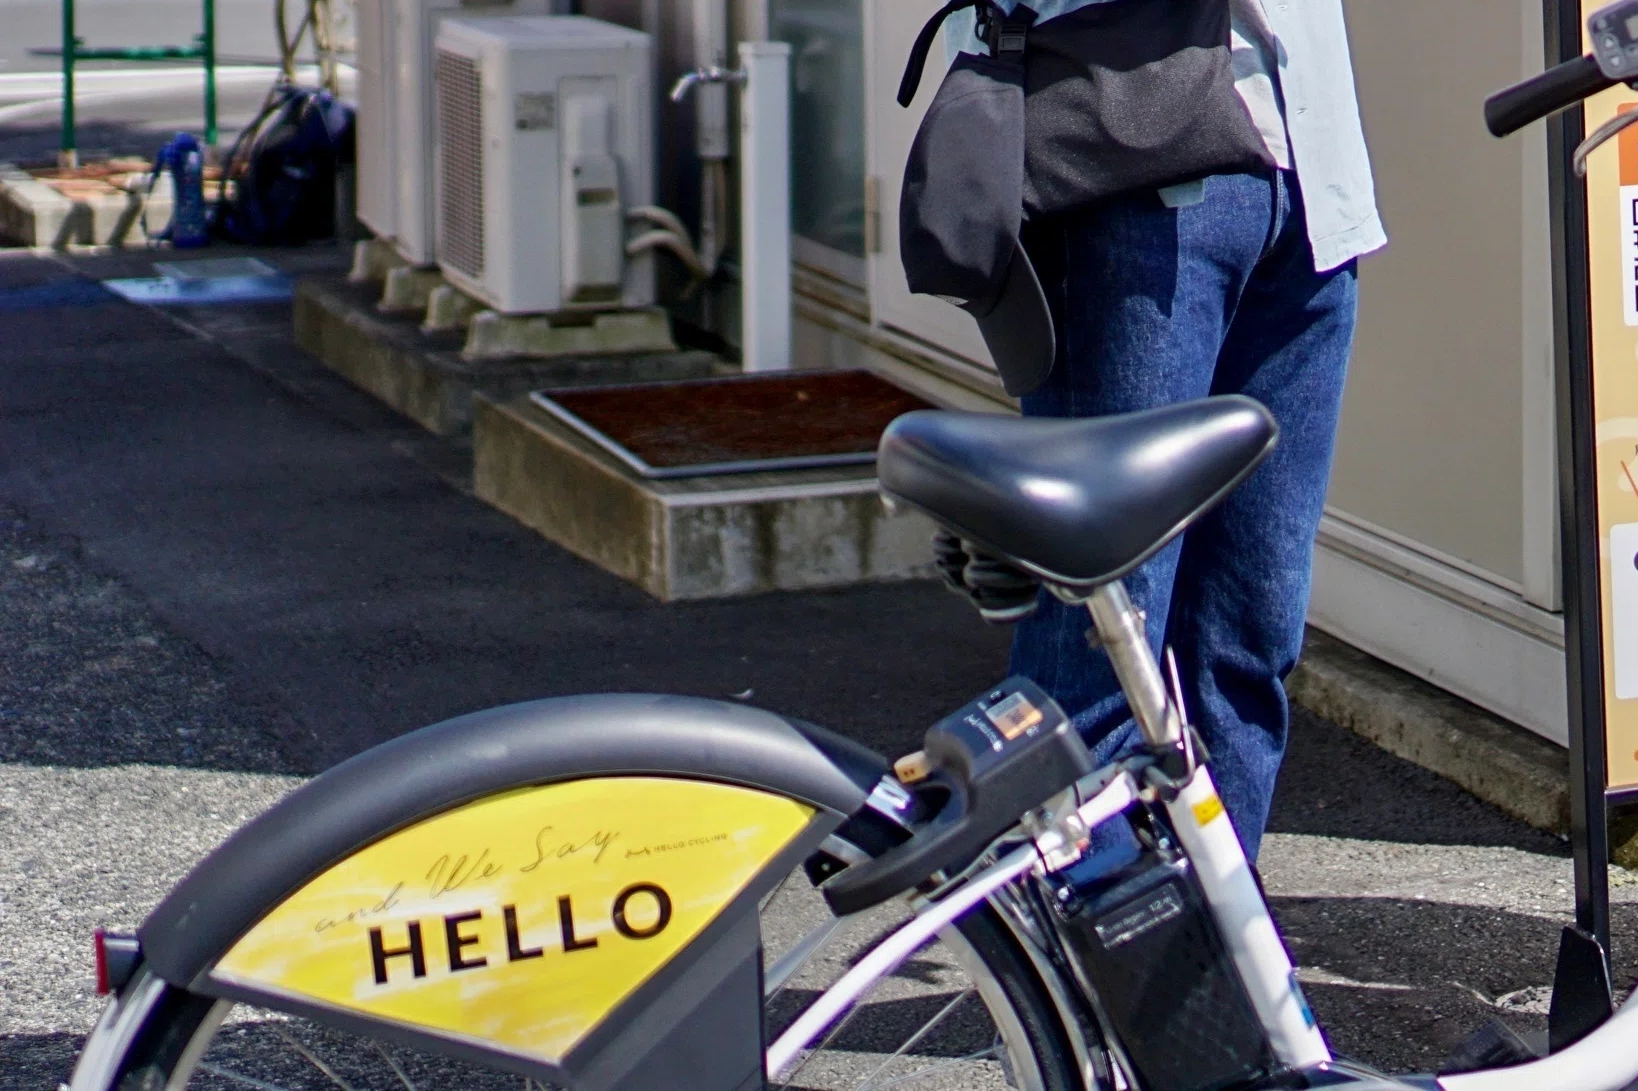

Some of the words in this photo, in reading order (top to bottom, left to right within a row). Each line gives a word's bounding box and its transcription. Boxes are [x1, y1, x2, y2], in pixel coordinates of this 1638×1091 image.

[425, 848, 502, 900] We
[520, 826, 620, 874] Say
[654, 840, 685, 853] HELLO
[687, 832, 728, 848] CYCLING
[367, 881, 673, 986] HELLO
